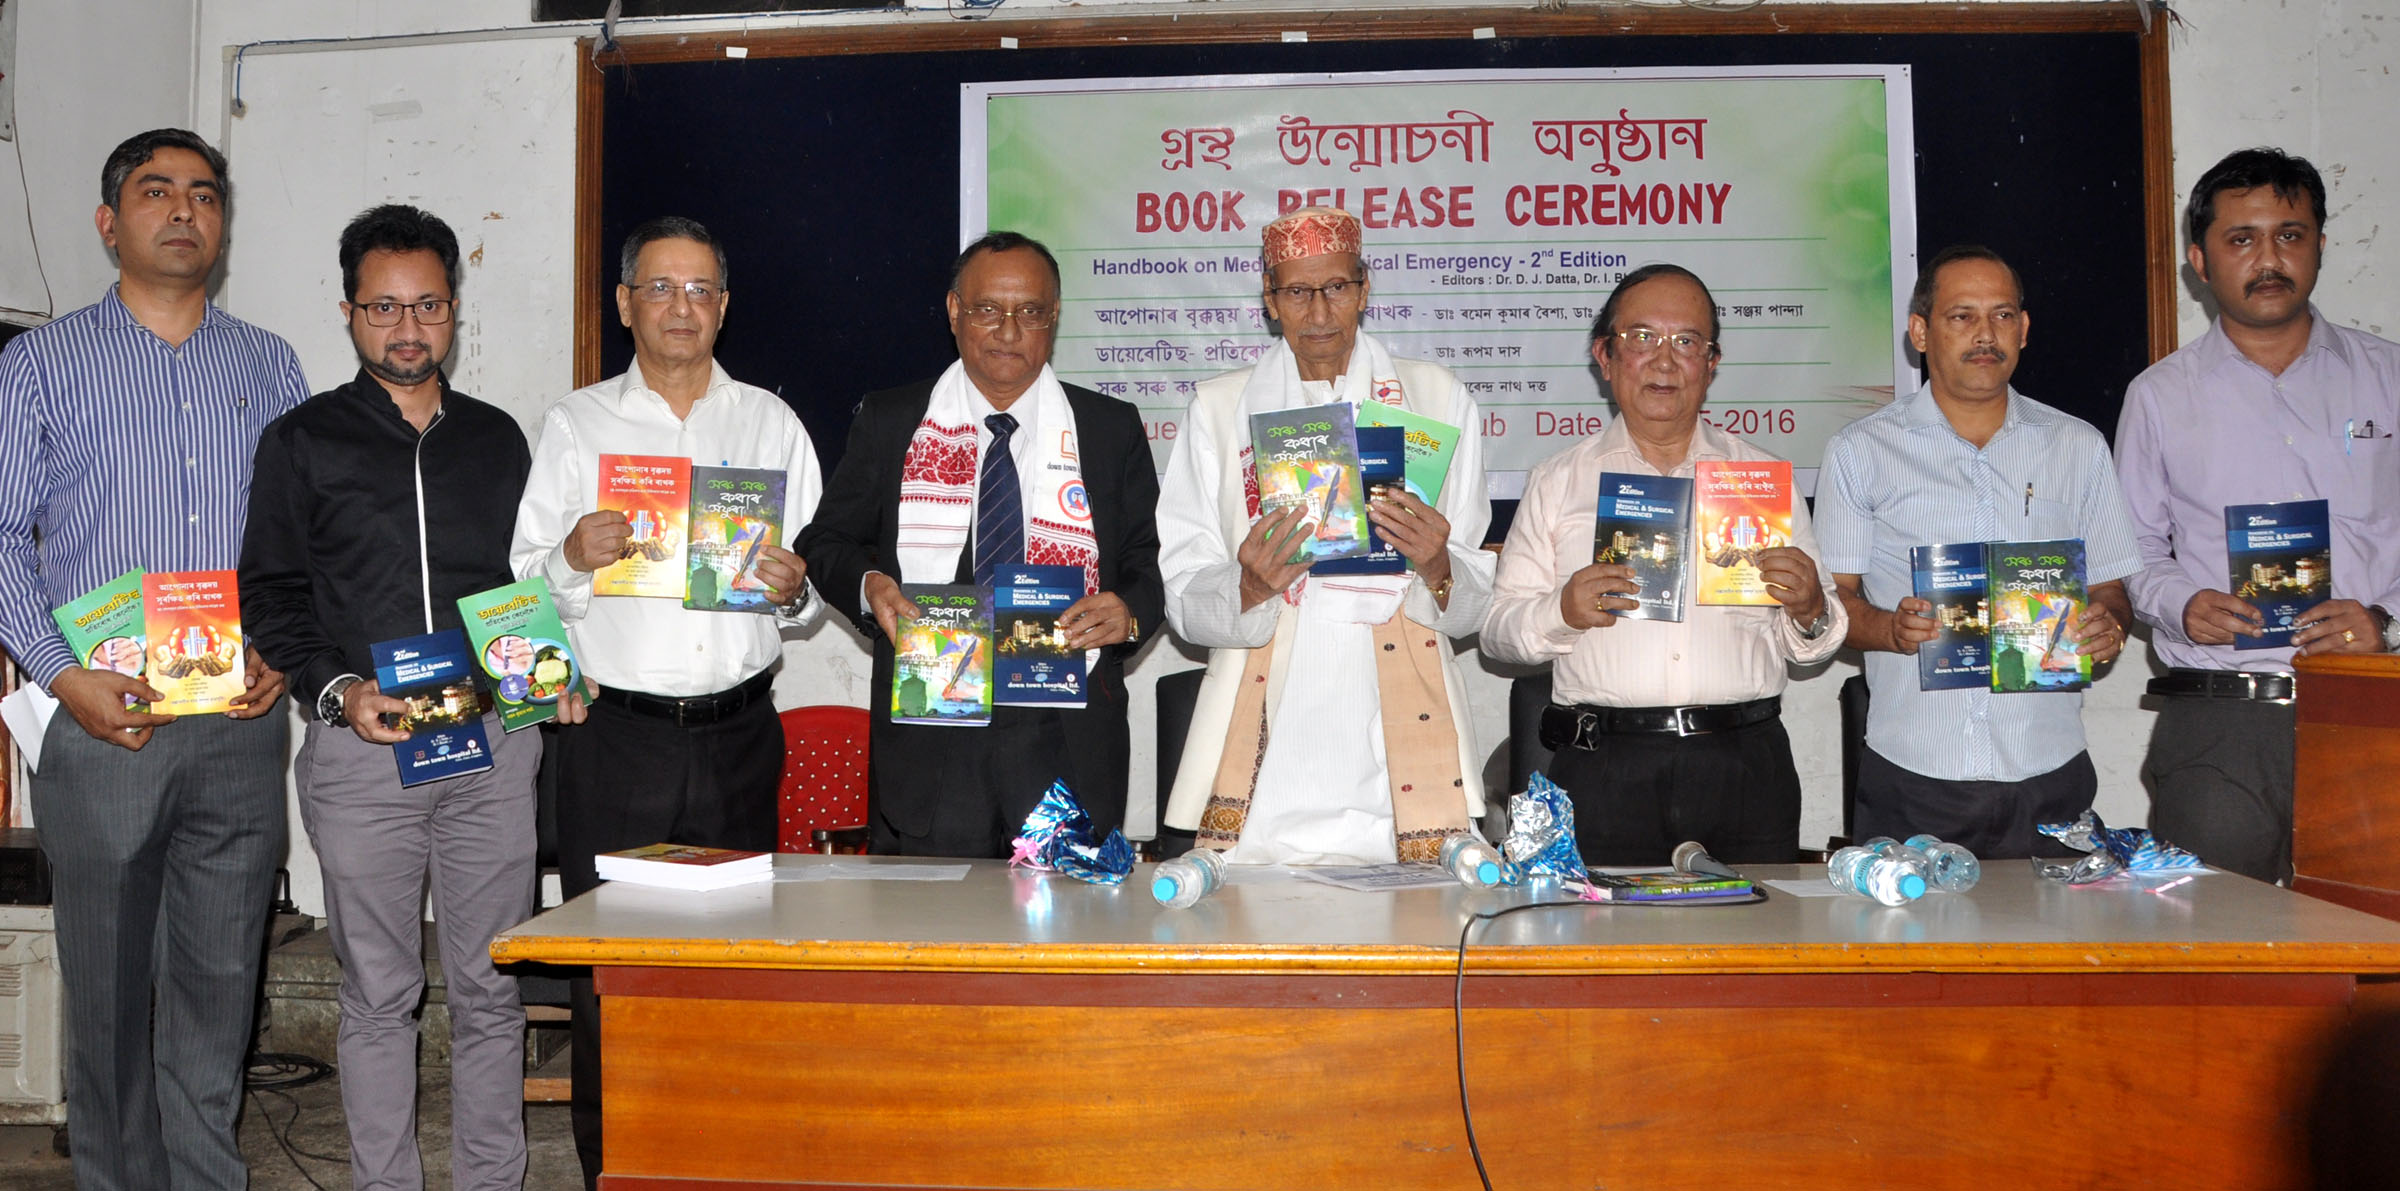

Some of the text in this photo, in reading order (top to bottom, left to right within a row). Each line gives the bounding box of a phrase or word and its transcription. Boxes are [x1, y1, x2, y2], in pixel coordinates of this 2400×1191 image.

[1532, 108, 1708, 177] অনুষ্ঠান
[1136, 190, 1247, 233] BOOK
[1505, 183, 1732, 226] CEREMONY
[1093, 257, 1188, 275] Handbook
[1194, 260, 1217, 273] on
[1406, 253, 1512, 273] Emergency
[1560, 251, 1627, 268] Edition
[1442, 275, 1485, 286] Editors
[1496, 274, 1512, 285] Dr.
[1516, 274, 1528, 285] D.
[1532, 274, 1541, 284] J.
[1546, 273, 1580, 286] Datta,
[1584, 273, 1600, 284] Dr.
[1536, 411, 1602, 436] Date
